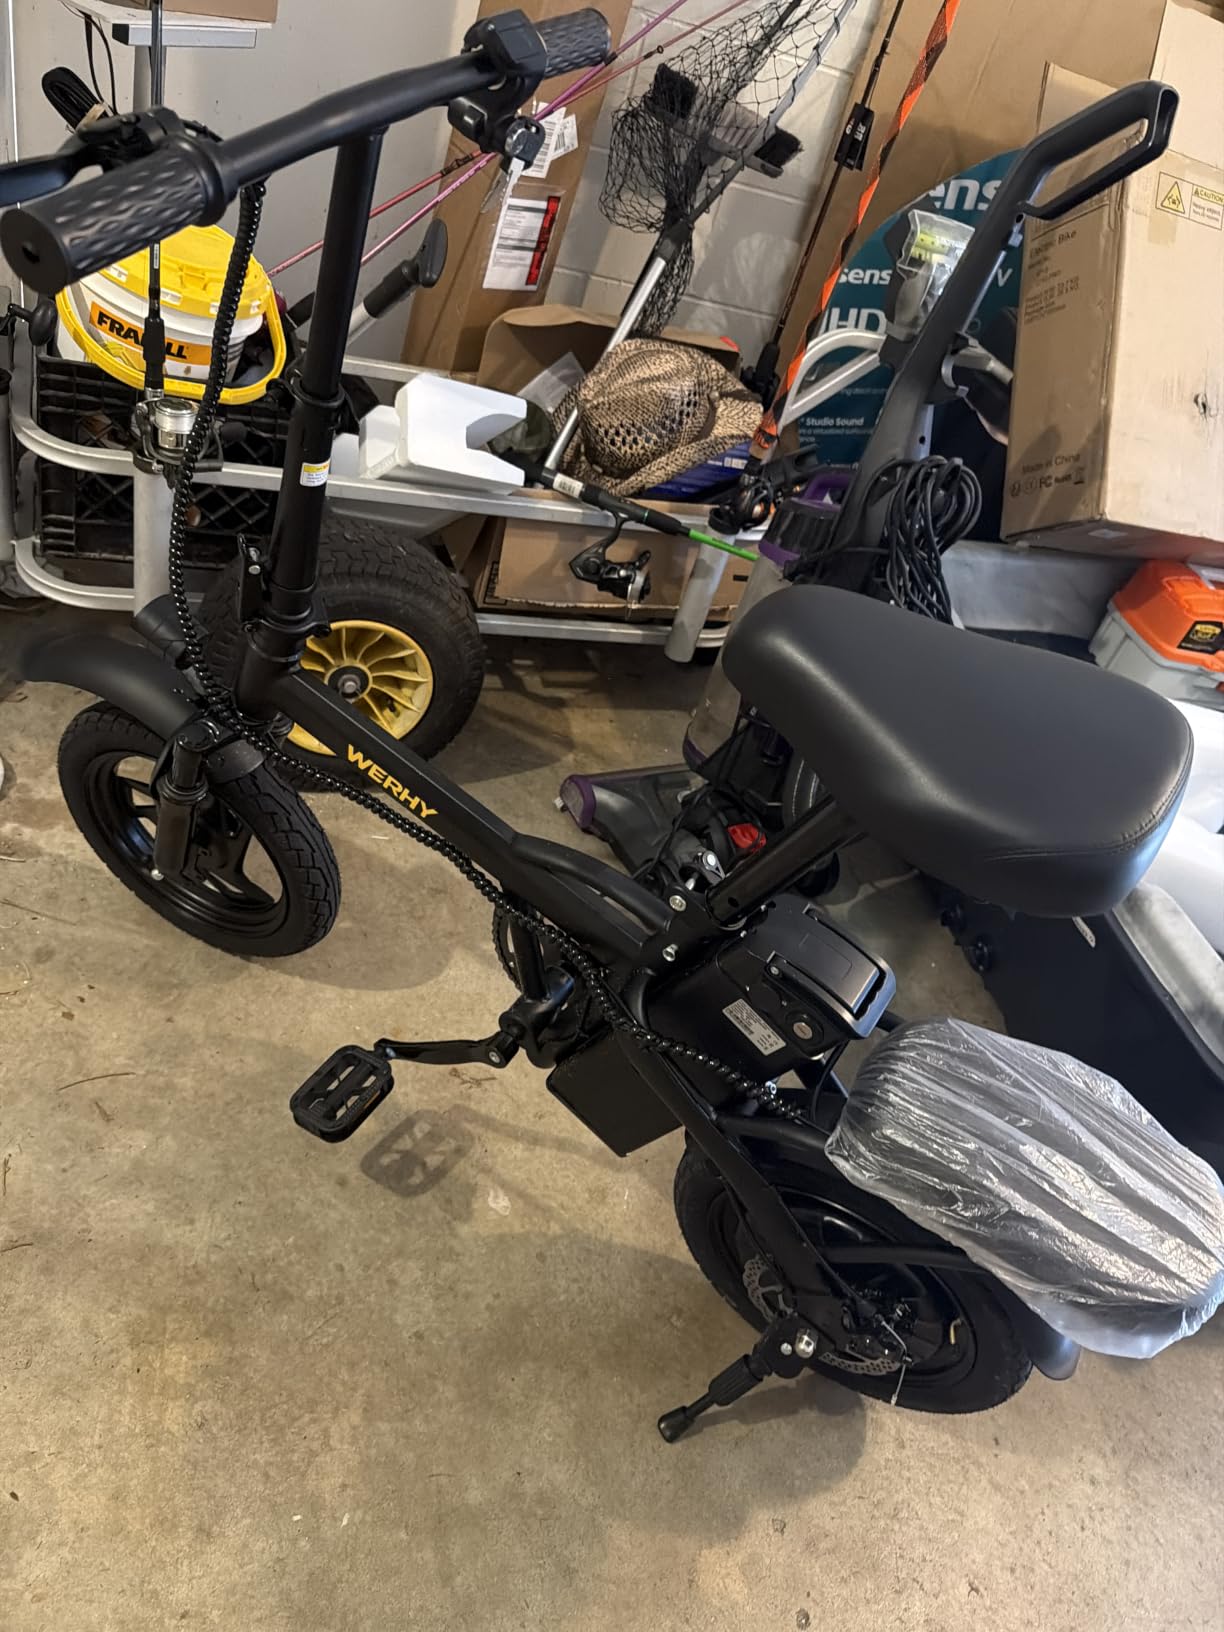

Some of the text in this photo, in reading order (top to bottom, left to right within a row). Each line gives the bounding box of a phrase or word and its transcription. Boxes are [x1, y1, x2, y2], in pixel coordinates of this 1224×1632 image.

[97, 310, 187, 359] FRALL
[819, 307, 888, 334] HD
[836, 417, 865, 426] Sound
[347, 743, 439, 818] WERHY
